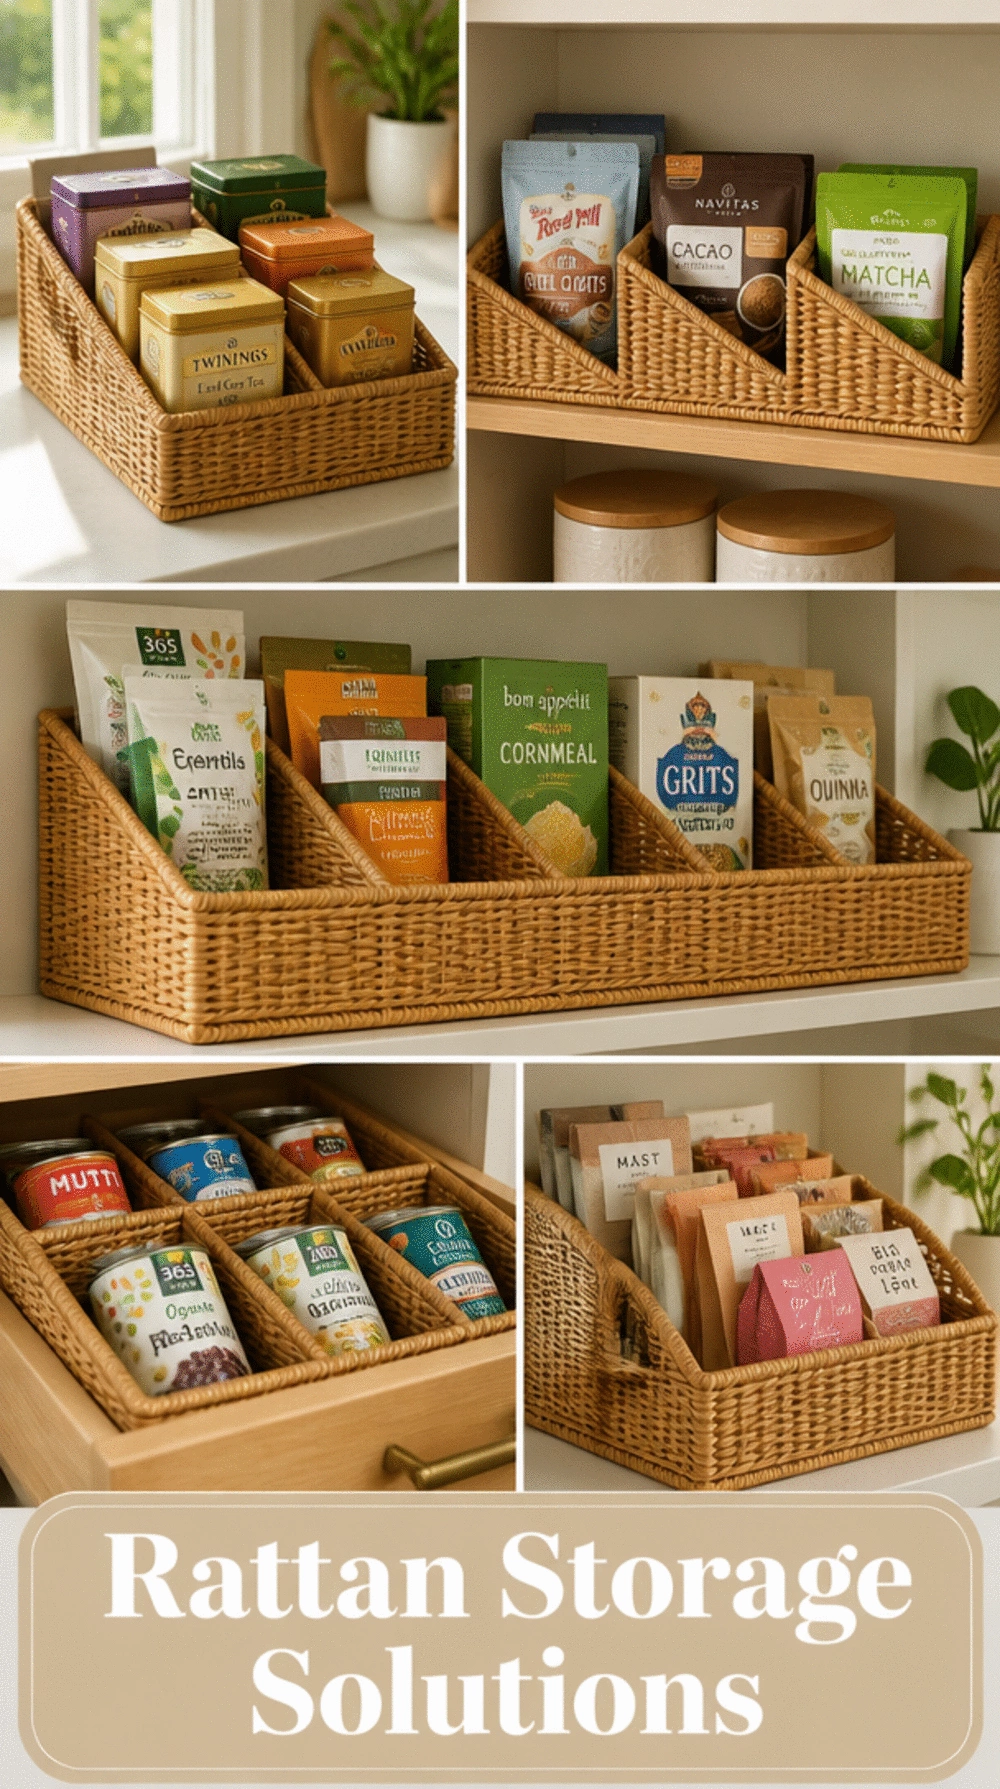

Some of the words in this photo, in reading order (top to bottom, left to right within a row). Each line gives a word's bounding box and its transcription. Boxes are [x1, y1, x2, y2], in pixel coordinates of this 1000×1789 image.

[695, 198, 760, 211] NAVITAS
[671, 241, 733, 260] CACAO
[841, 264, 932, 290] MATCHA
[192, 348, 269, 373] TWININGS
[143, 635, 178, 654] 365
[500, 742, 598, 765] CORNMEAL
[663, 764, 735, 796] GRITS
[616, 1152, 661, 1170] MAST
[50, 1168, 121, 1197] MUTTI
[161, 1261, 196, 1281] 365
